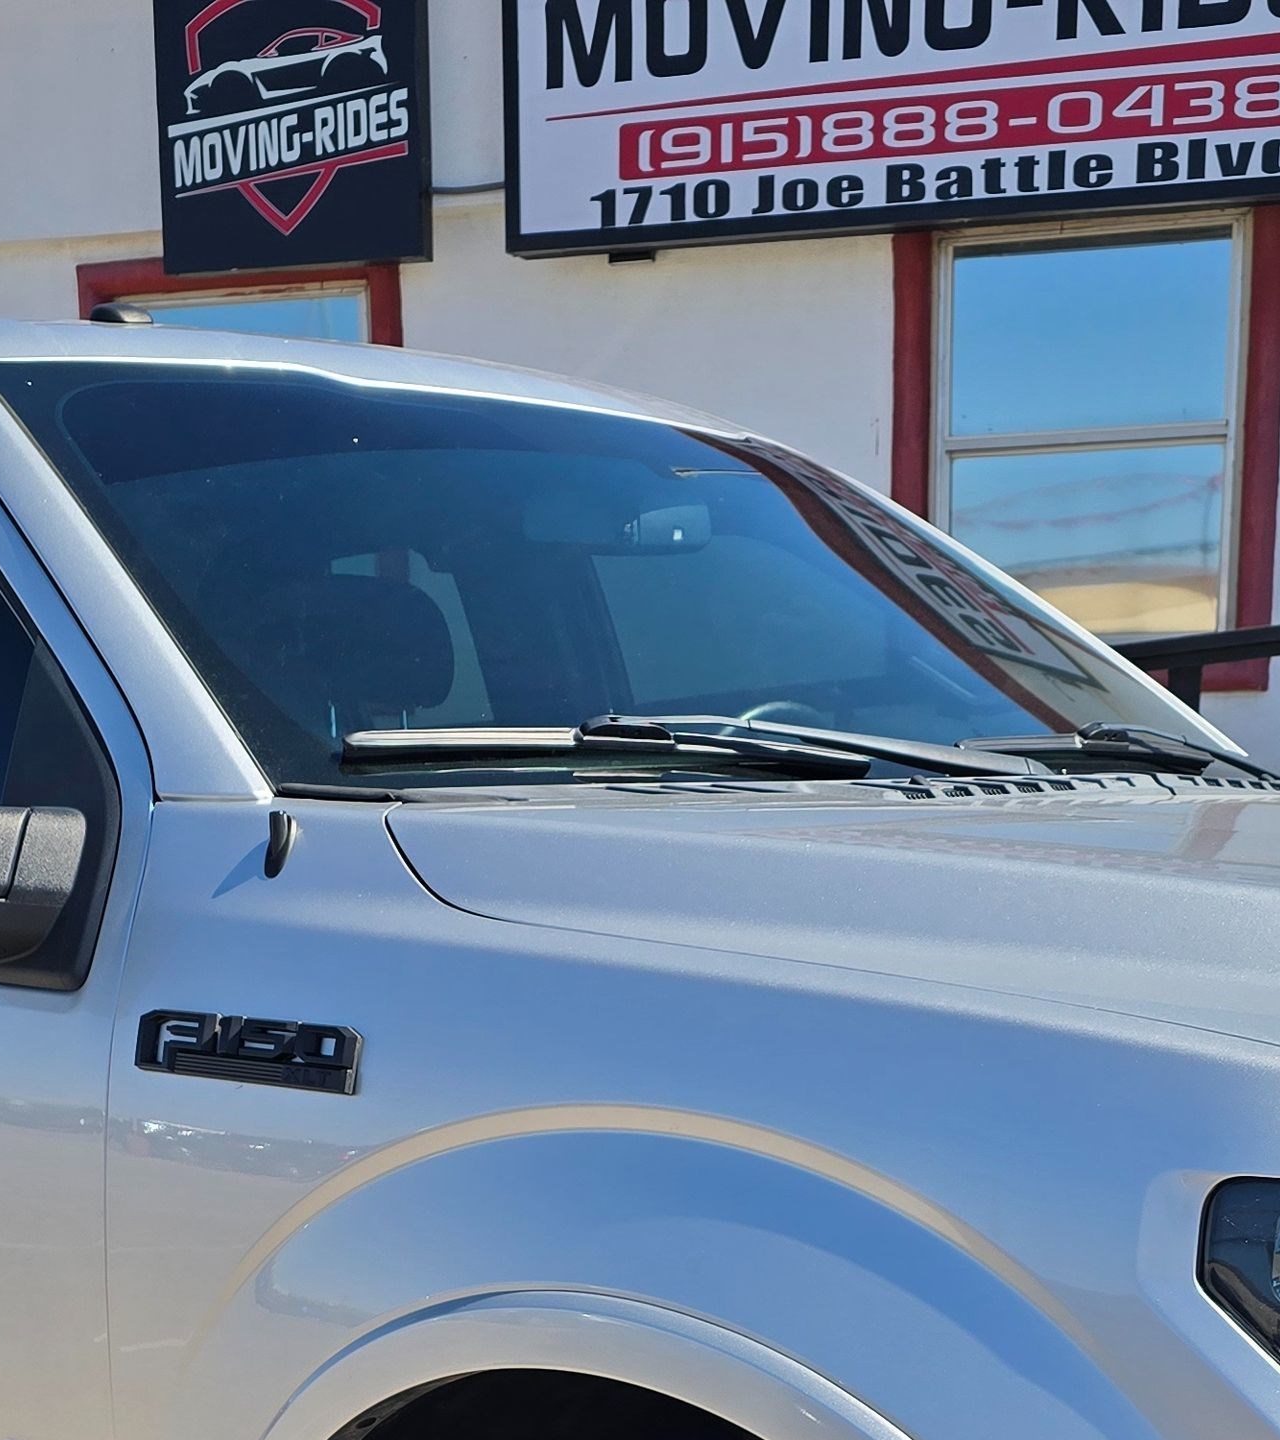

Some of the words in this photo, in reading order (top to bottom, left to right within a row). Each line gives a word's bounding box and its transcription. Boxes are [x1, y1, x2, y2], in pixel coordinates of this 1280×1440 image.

[173, 87, 409, 189] MOVING-RIDES
[590, 178, 731, 229] 1710
[751, 174, 865, 215] Joe
[884, 150, 1114, 205] Battle
